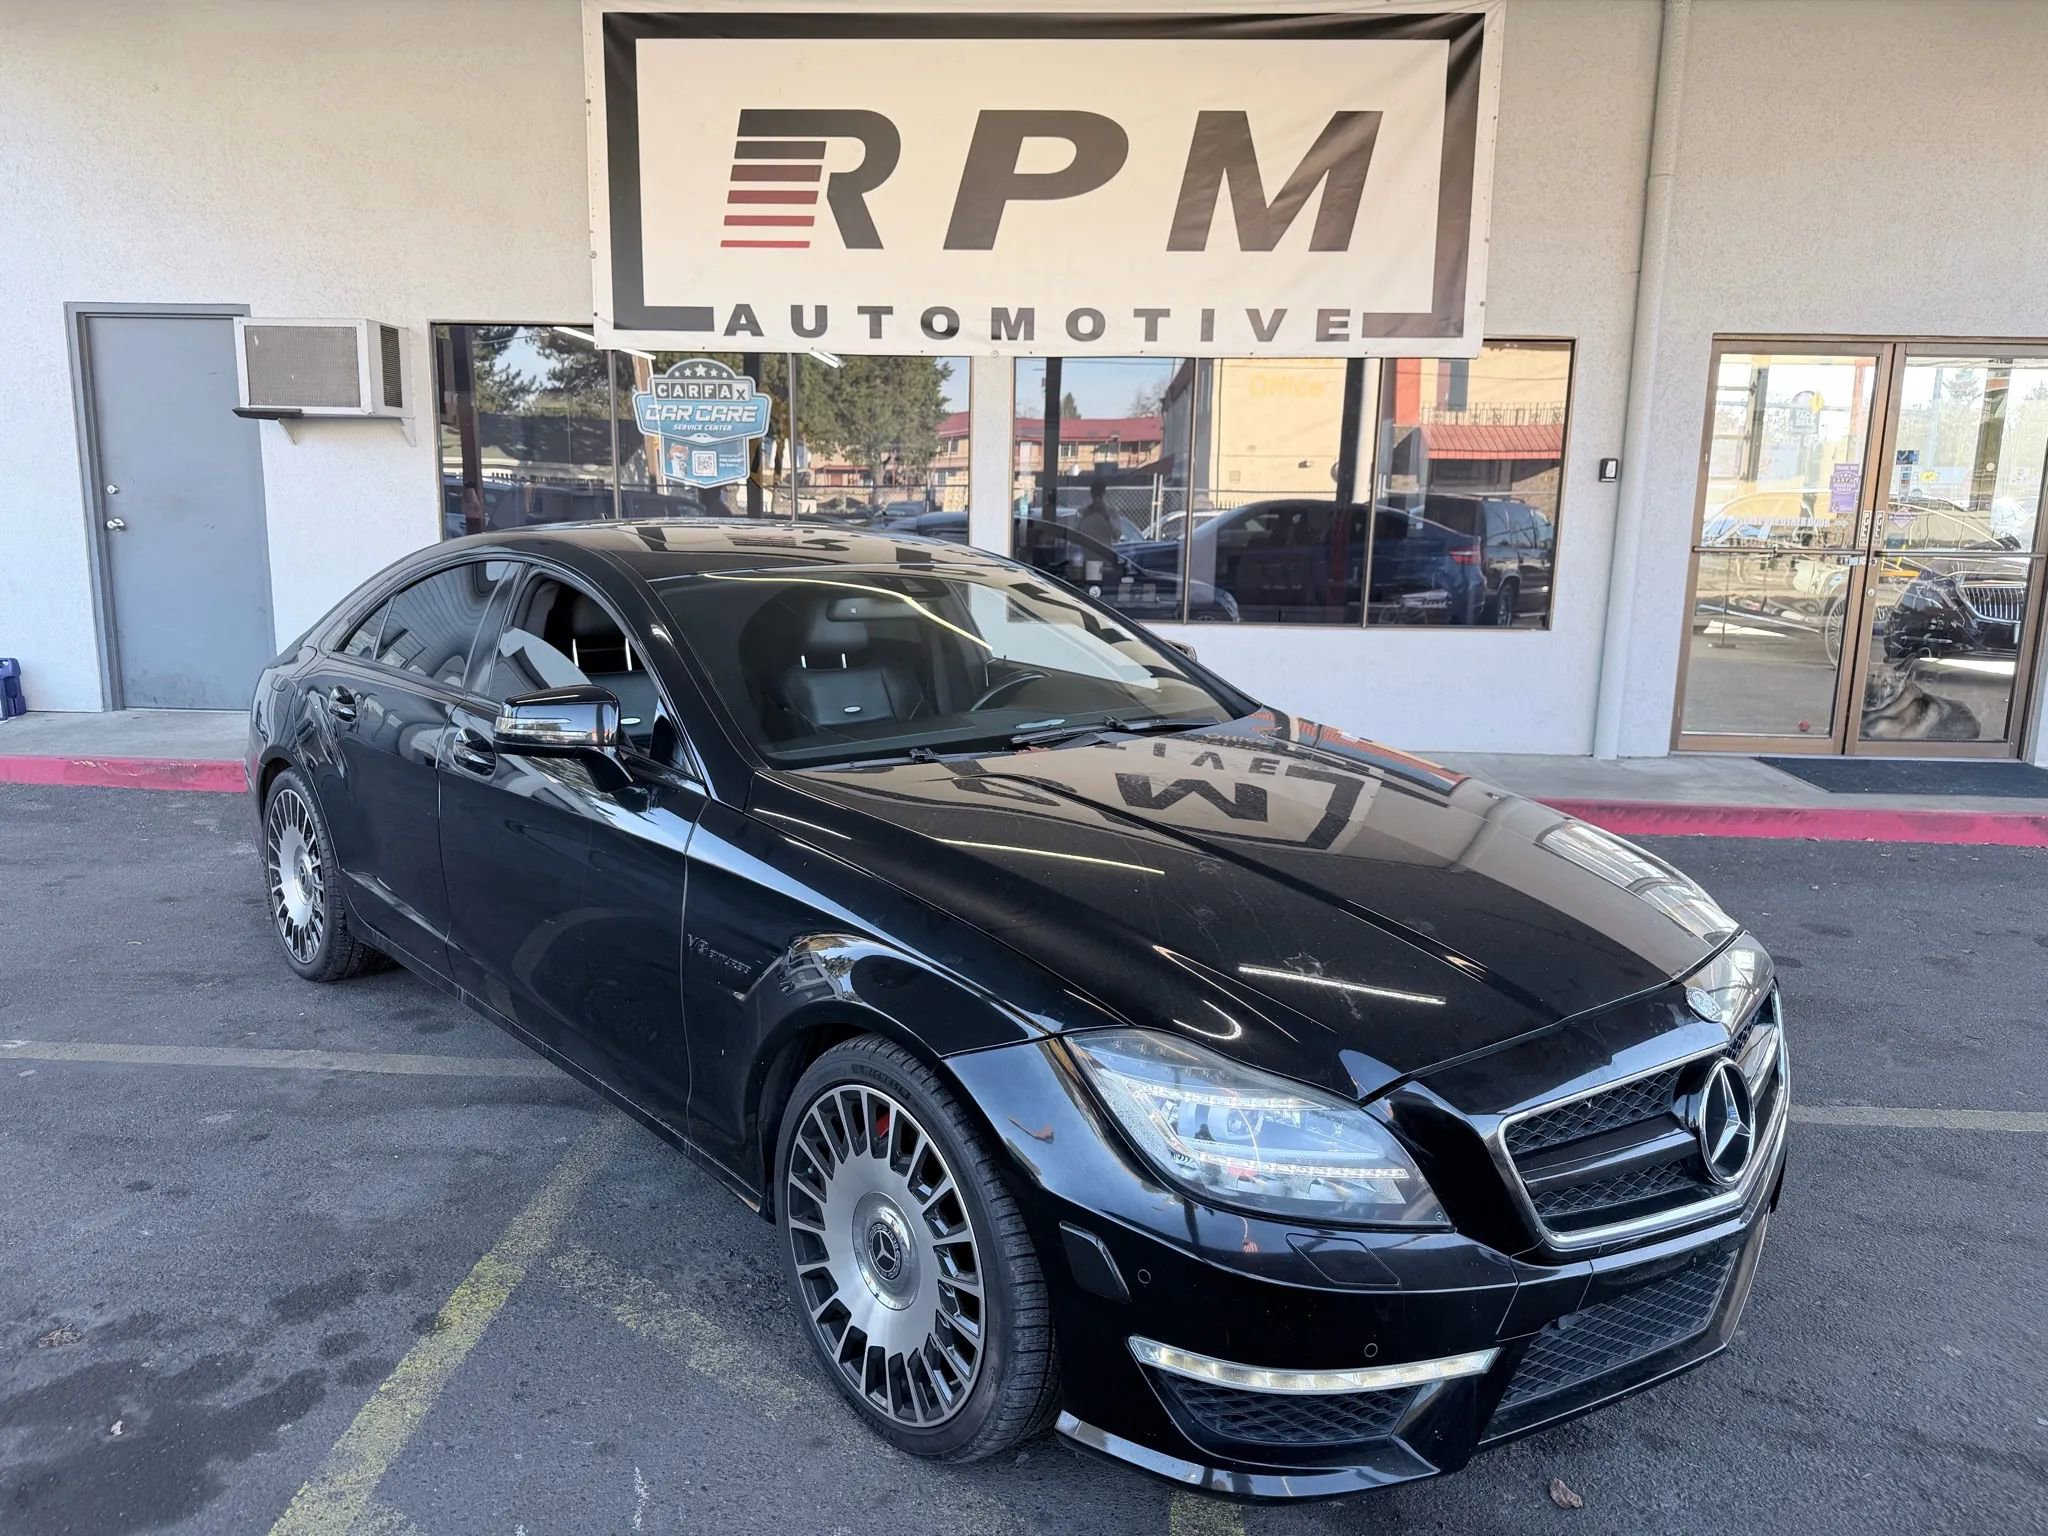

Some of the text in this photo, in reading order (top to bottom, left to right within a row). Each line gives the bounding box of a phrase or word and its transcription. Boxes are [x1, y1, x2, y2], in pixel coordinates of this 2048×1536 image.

[720, 109, 1384, 253] RPM
[723, 303, 1352, 343] AUTOMOTIVE
[656, 384, 746, 400] CARFAX
[645, 404, 758, 422] CAR CARE
